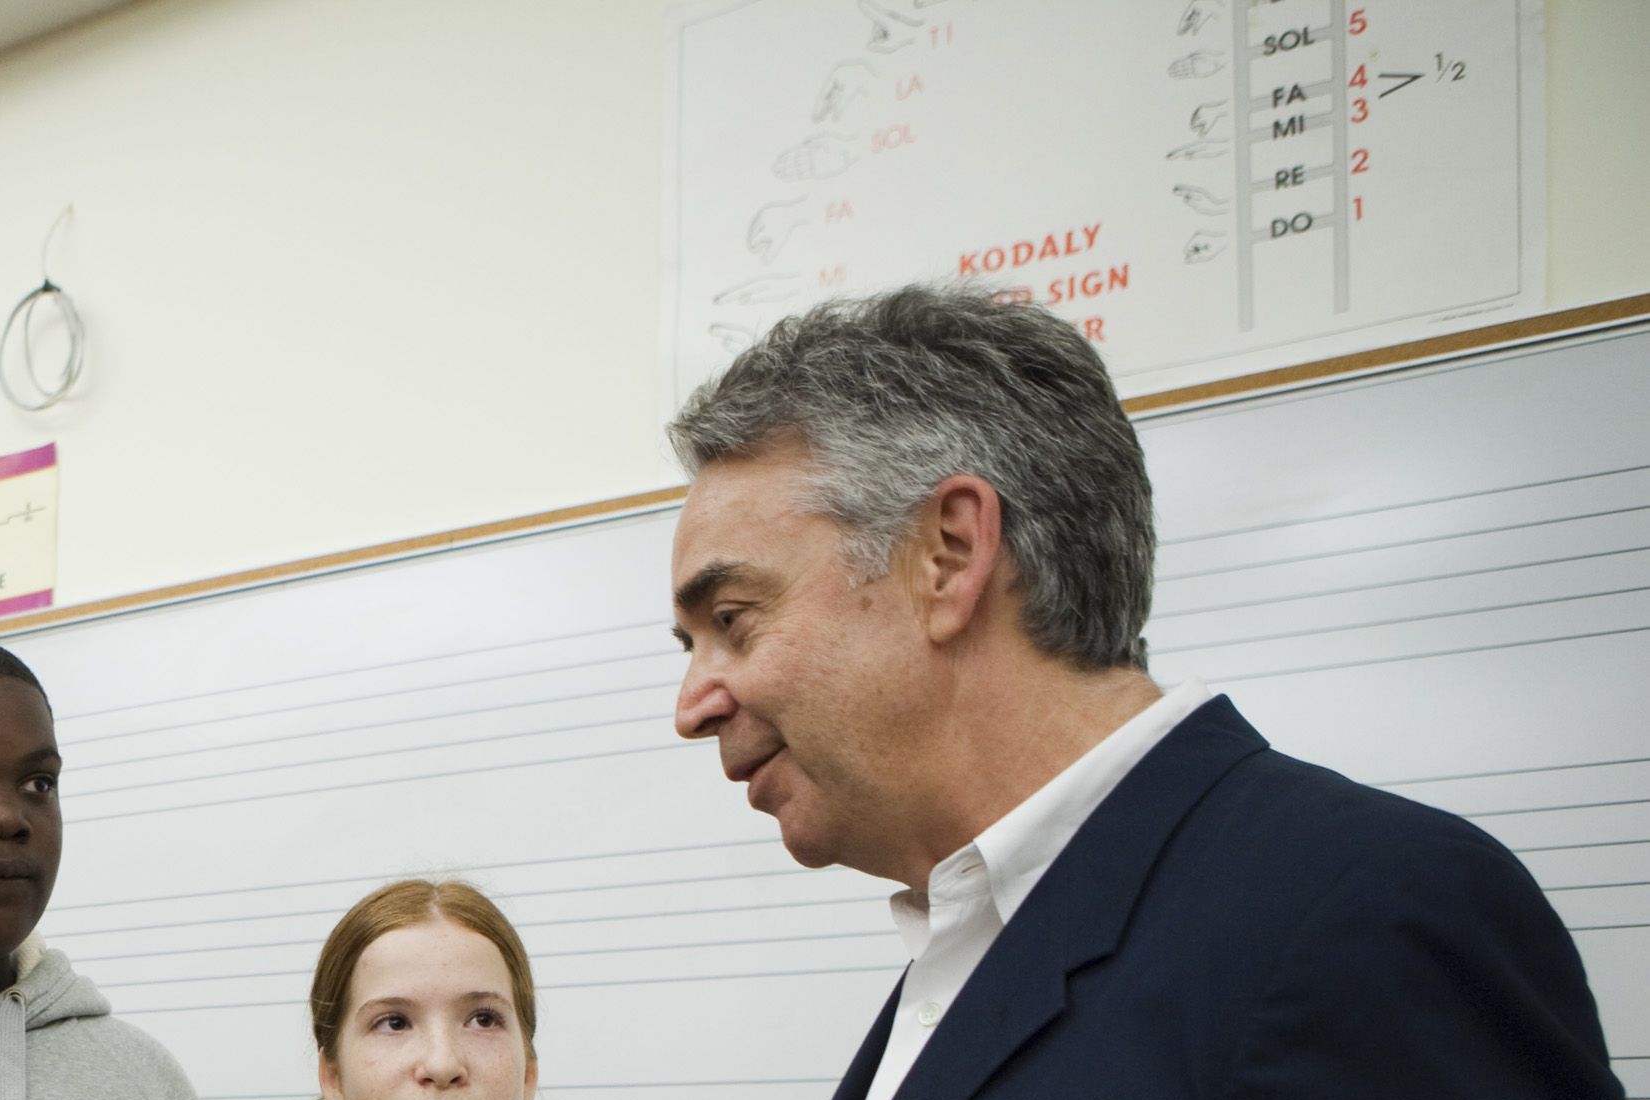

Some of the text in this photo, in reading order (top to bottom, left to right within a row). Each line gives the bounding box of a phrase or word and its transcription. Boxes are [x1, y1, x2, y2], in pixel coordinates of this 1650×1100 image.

[1348, 8, 1368, 35] 5
[1262, 26, 1315, 56] SOL
[895, 74, 924, 101] LA
[1348, 64, 1368, 88] 4
[1271, 83, 1307, 109] FA
[1351, 97, 1369, 123] 3
[1272, 114, 1305, 140] MI
[1351, 148, 1370, 175] 2
[1274, 165, 1305, 190] RE
[1352, 196, 1363, 221] 1
[1270, 211, 1314, 239] DO
[958, 222, 1101, 277] KODALY
[1046, 263, 1130, 305] SIGN
